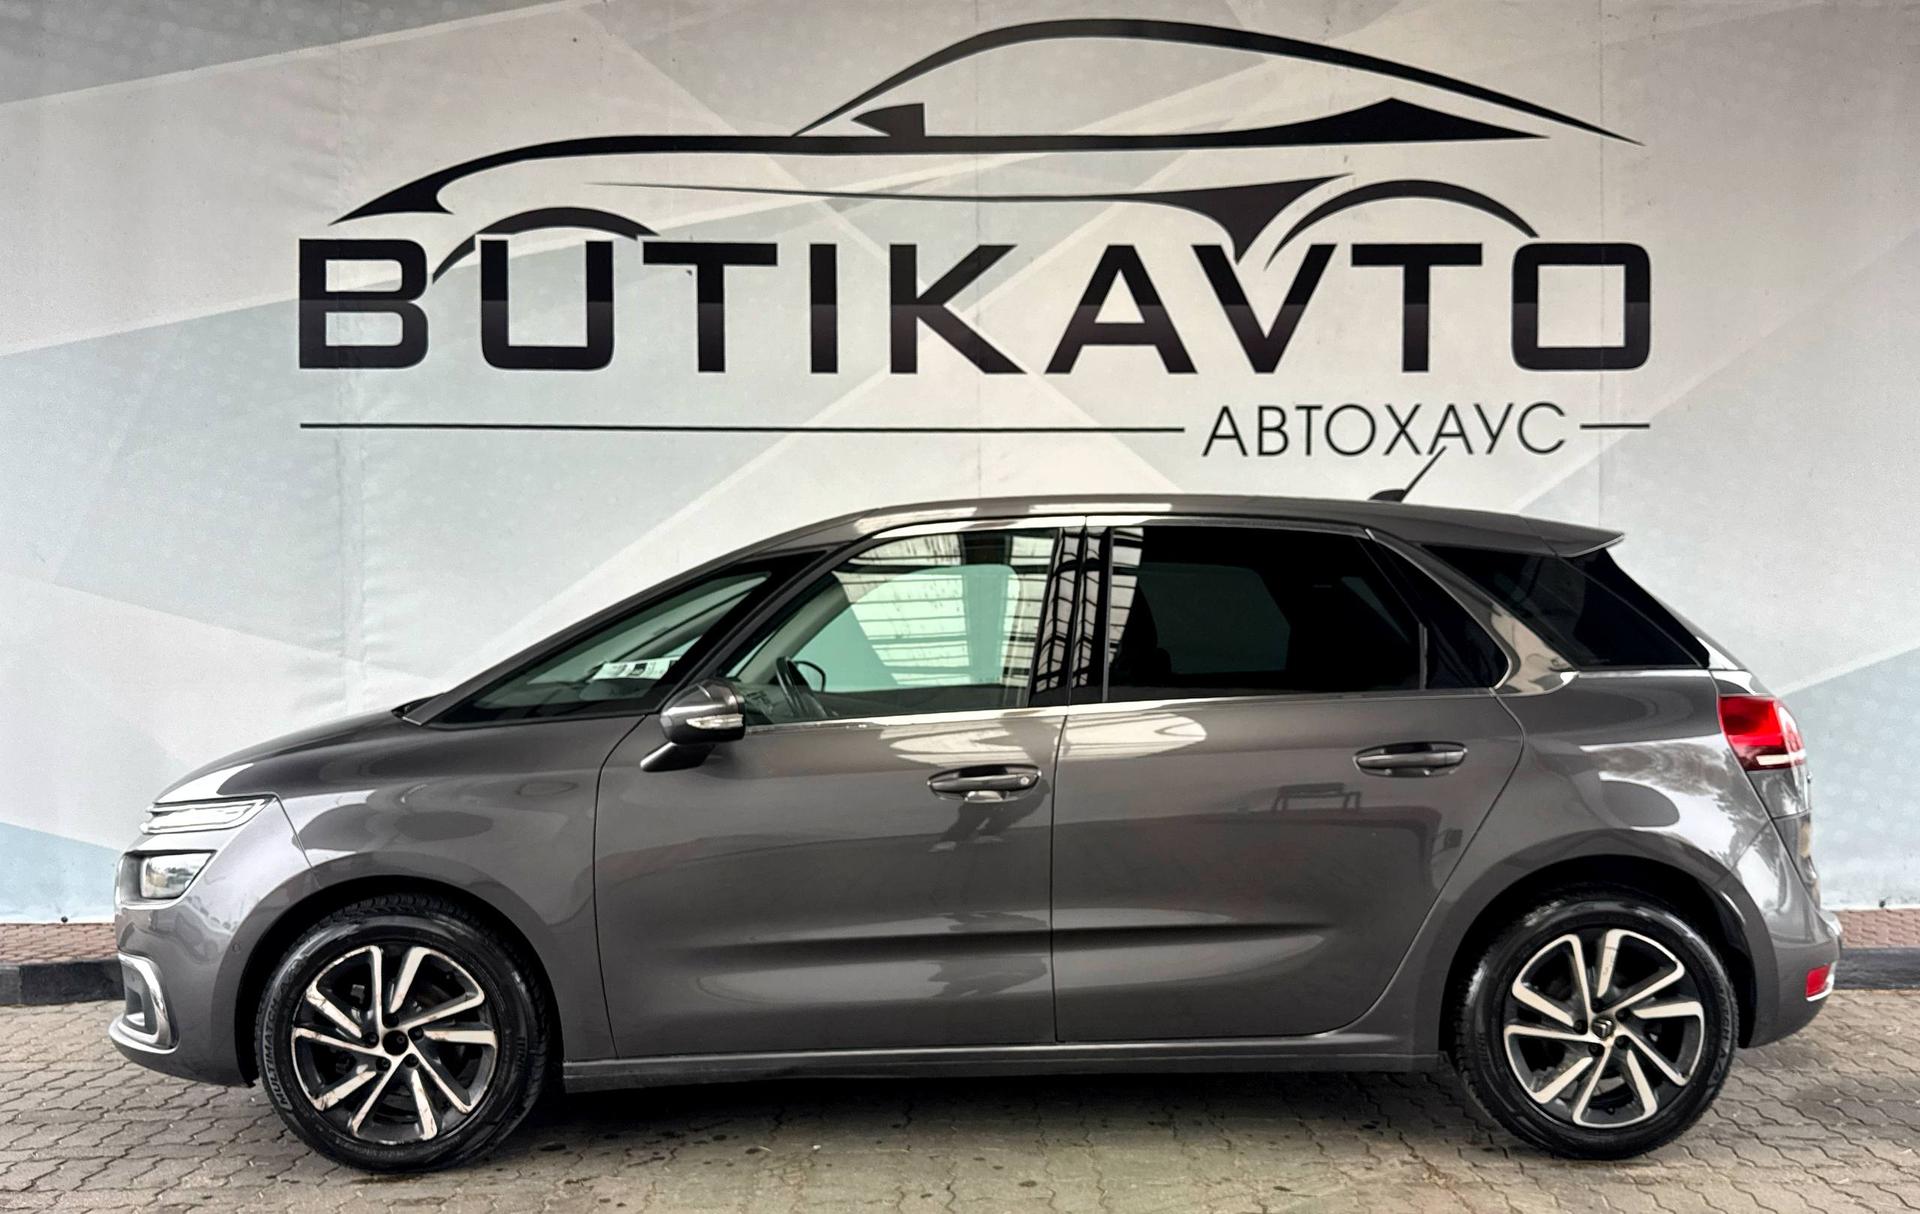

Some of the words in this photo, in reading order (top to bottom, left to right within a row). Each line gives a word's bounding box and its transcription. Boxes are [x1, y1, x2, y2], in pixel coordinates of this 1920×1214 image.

[299, 239, 1651, 374] BUTIKAVTO
[1202, 403, 1566, 457] АВТОХАУС
[263, 997, 288, 1106] MULTIMATCH
